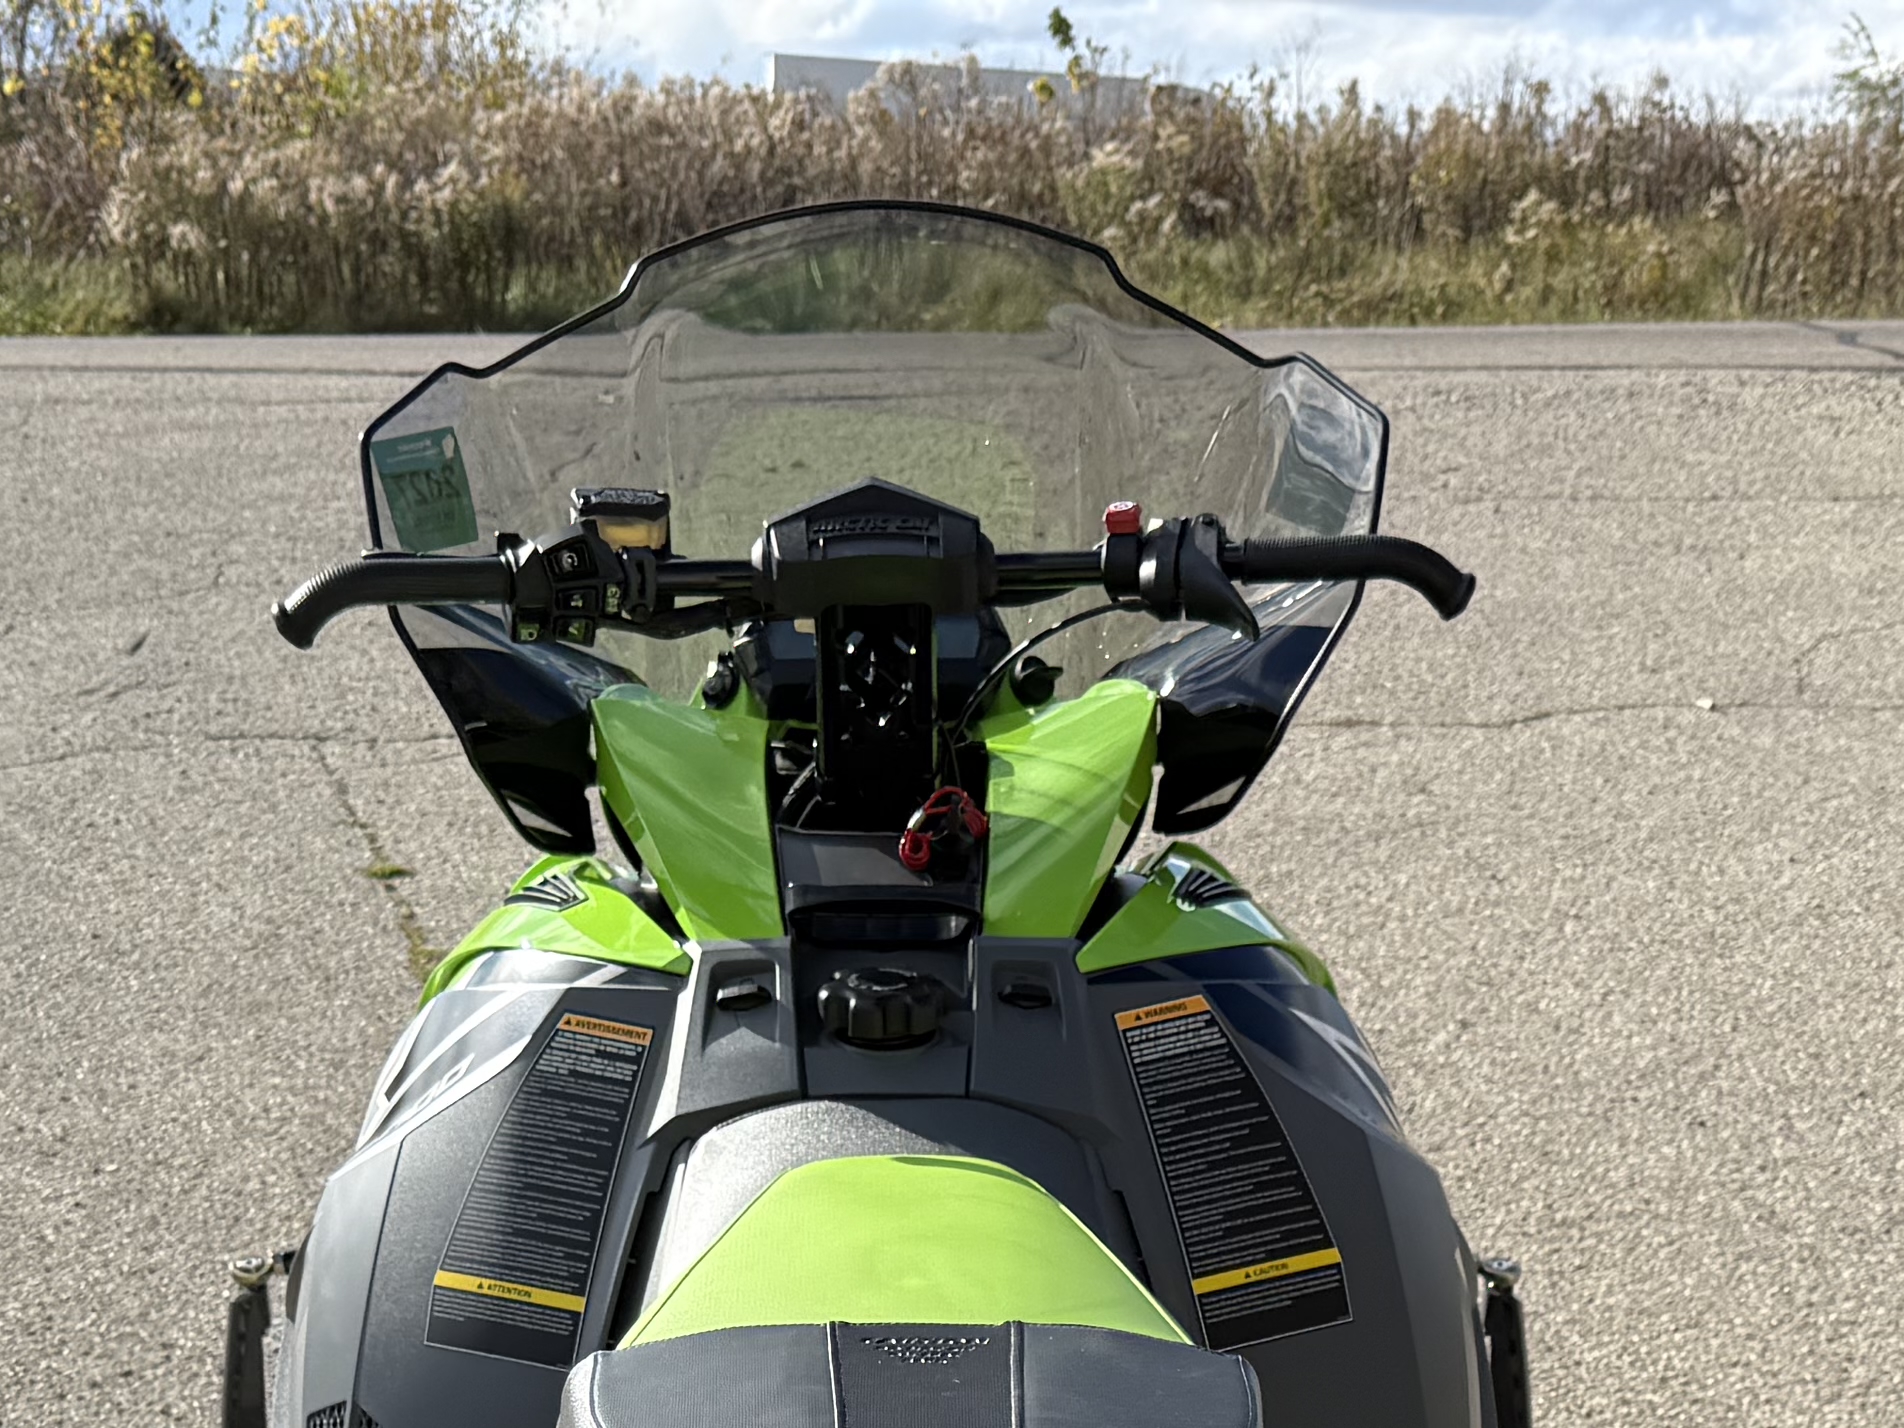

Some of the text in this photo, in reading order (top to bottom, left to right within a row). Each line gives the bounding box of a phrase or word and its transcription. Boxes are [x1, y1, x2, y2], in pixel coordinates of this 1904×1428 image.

[1144, 1002, 1188, 1019] WARNING
[575, 1020, 648, 1041] AVERTISSEMENT
[1254, 1262, 1289, 1277] CAUTION
[487, 1284, 532, 1299] ATTENTION
